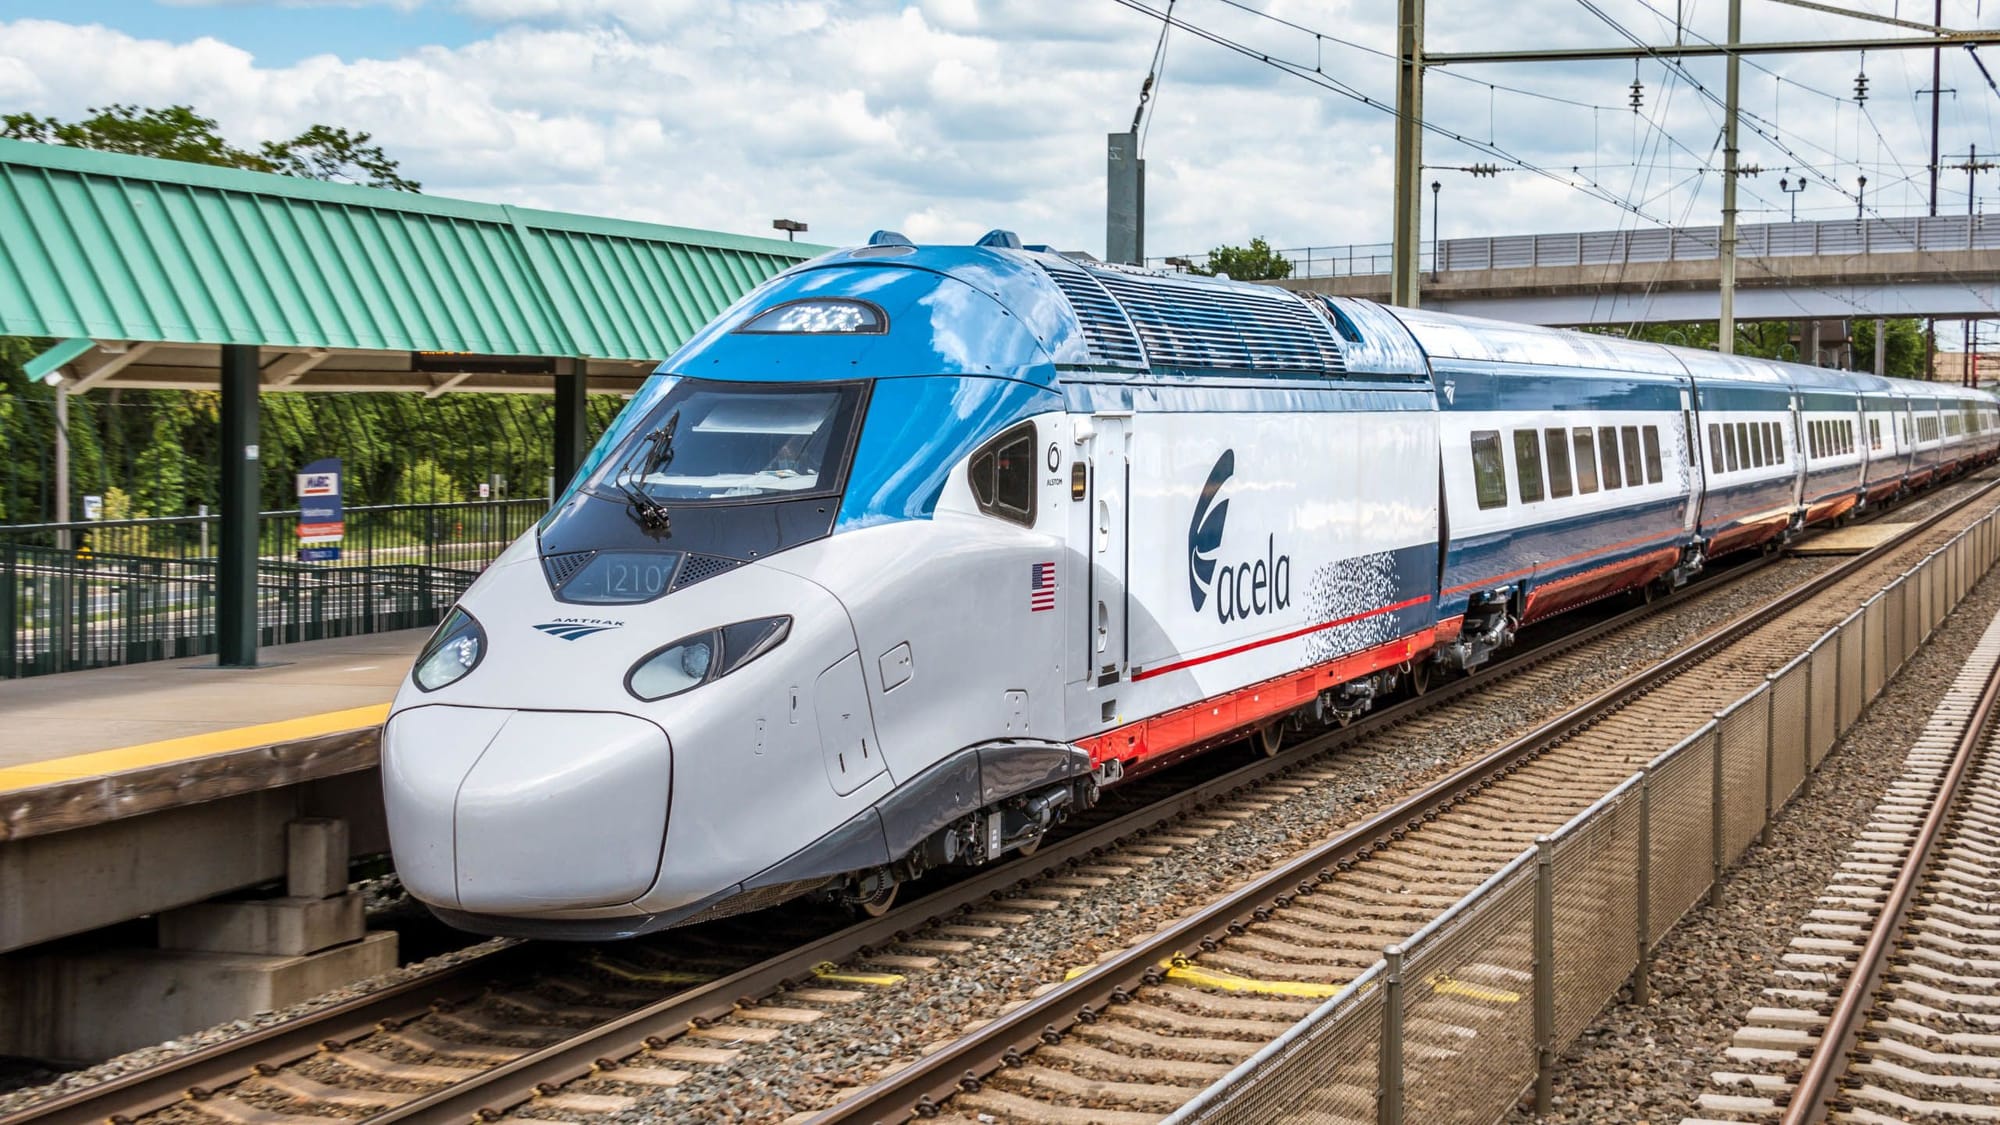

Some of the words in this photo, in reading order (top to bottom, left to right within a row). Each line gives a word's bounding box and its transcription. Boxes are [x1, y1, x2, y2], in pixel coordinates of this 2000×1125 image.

[1047, 478, 1063, 487] ALSTOM
[615, 564, 673, 593] 210
[1217, 532, 1290, 625] acela
[553, 617, 625, 627] AMTRAK
